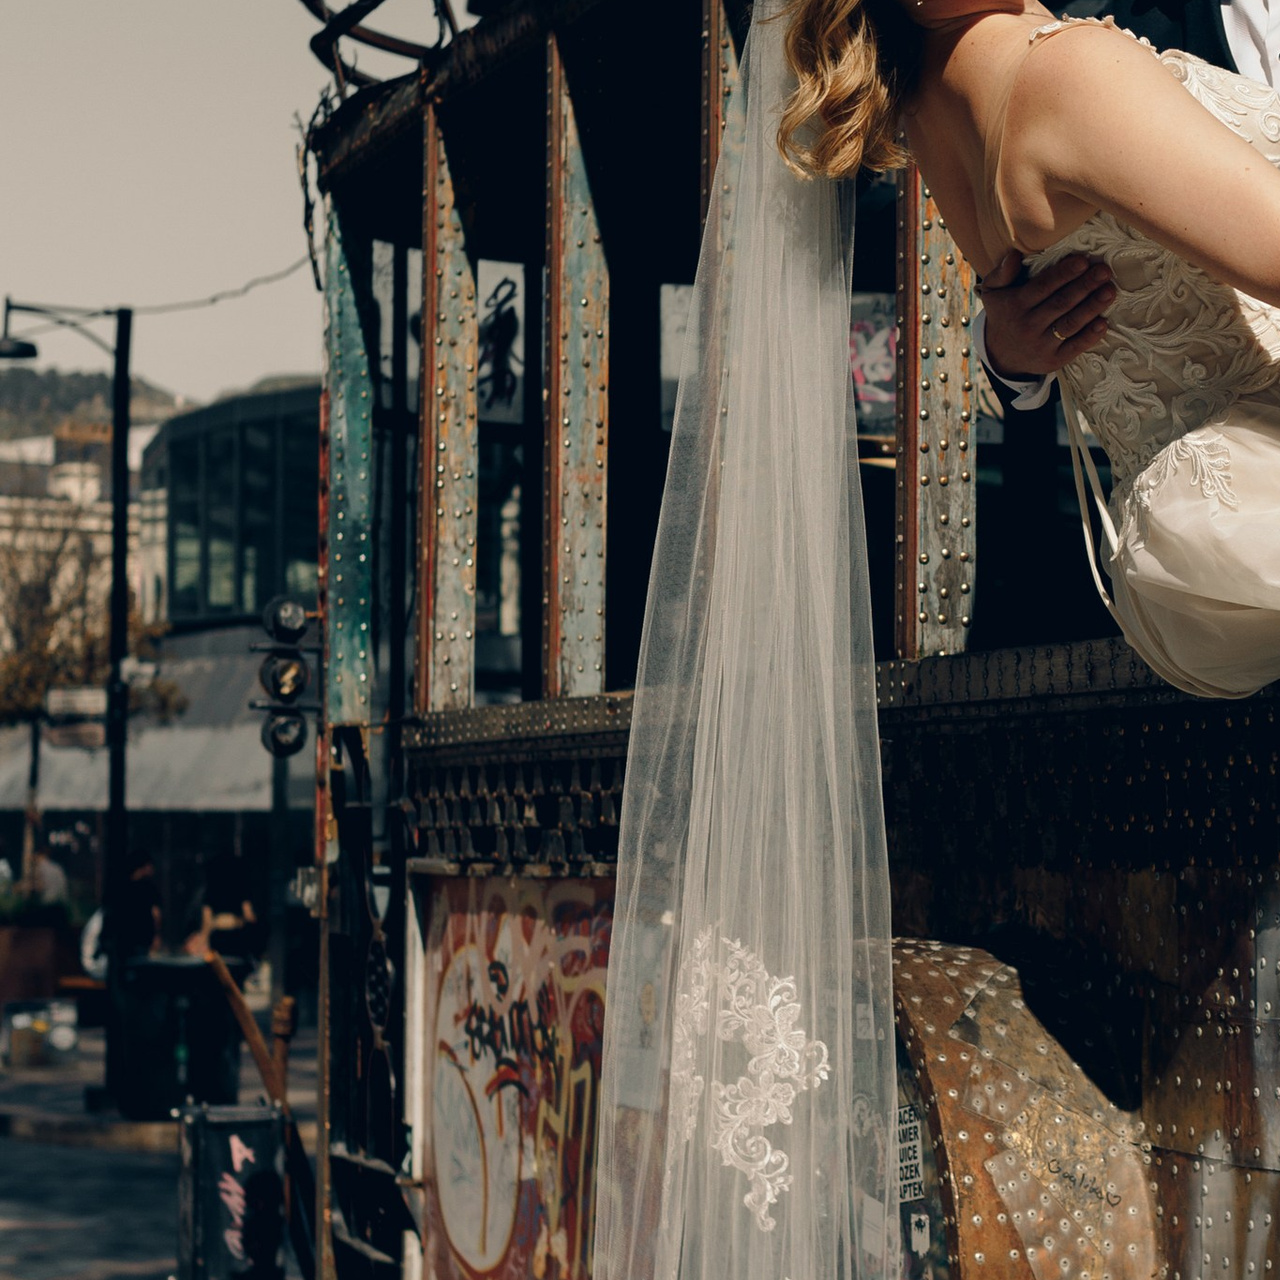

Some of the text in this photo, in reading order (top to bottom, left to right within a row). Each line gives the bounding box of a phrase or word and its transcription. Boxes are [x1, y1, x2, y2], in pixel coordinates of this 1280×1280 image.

[898, 1145, 918, 1163] UICE
[899, 1163, 921, 1181] OZEK
[899, 1181, 925, 1199] APTEK
